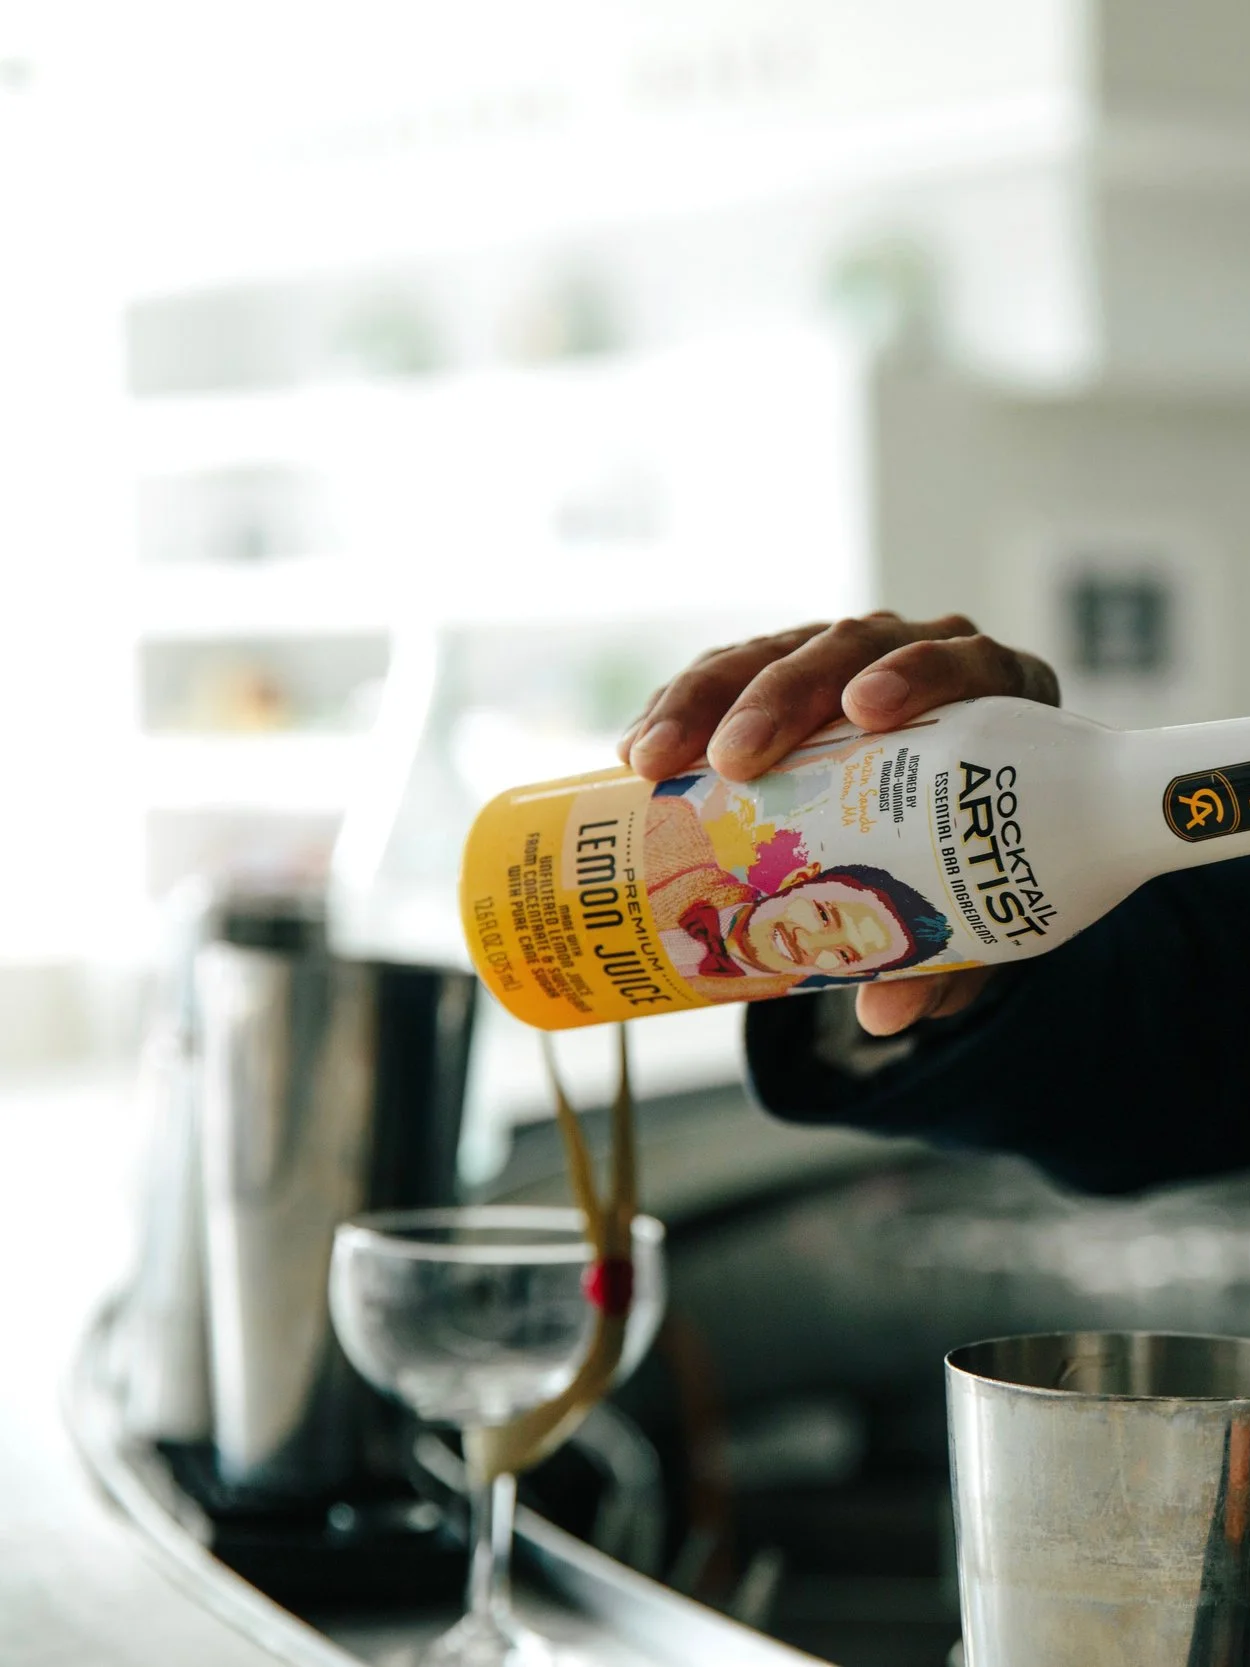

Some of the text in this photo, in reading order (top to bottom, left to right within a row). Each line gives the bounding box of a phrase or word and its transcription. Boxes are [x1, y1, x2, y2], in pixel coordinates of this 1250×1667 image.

[859, 747, 884, 787] Tenzin
[879, 760, 893, 812] MIXOLOGIST
[892, 747, 909, 824] AWARD-WINNING
[905, 754, 921, 809] INSPIRED BY
[523, 832, 540, 867] FROM
[935, 771, 998, 945] ESSENTIAL BAR INGREDIENTS
[959, 760, 1047, 938] ARTIST
[996, 765, 1058, 926] COCKTAIL
[507, 864, 522, 898] WITH
[539, 855, 559, 926] UNFILTERED
[510, 900, 529, 932] PURE
[523, 869, 552, 952] CONCENTRATE
[558, 903, 583, 957] MADE WITH
[576, 820, 674, 1006] LEMON JUICE
[622, 868, 665, 972] PREMIUM
[518, 935, 540, 966] CANE
[548, 929, 575, 969] LEMON
